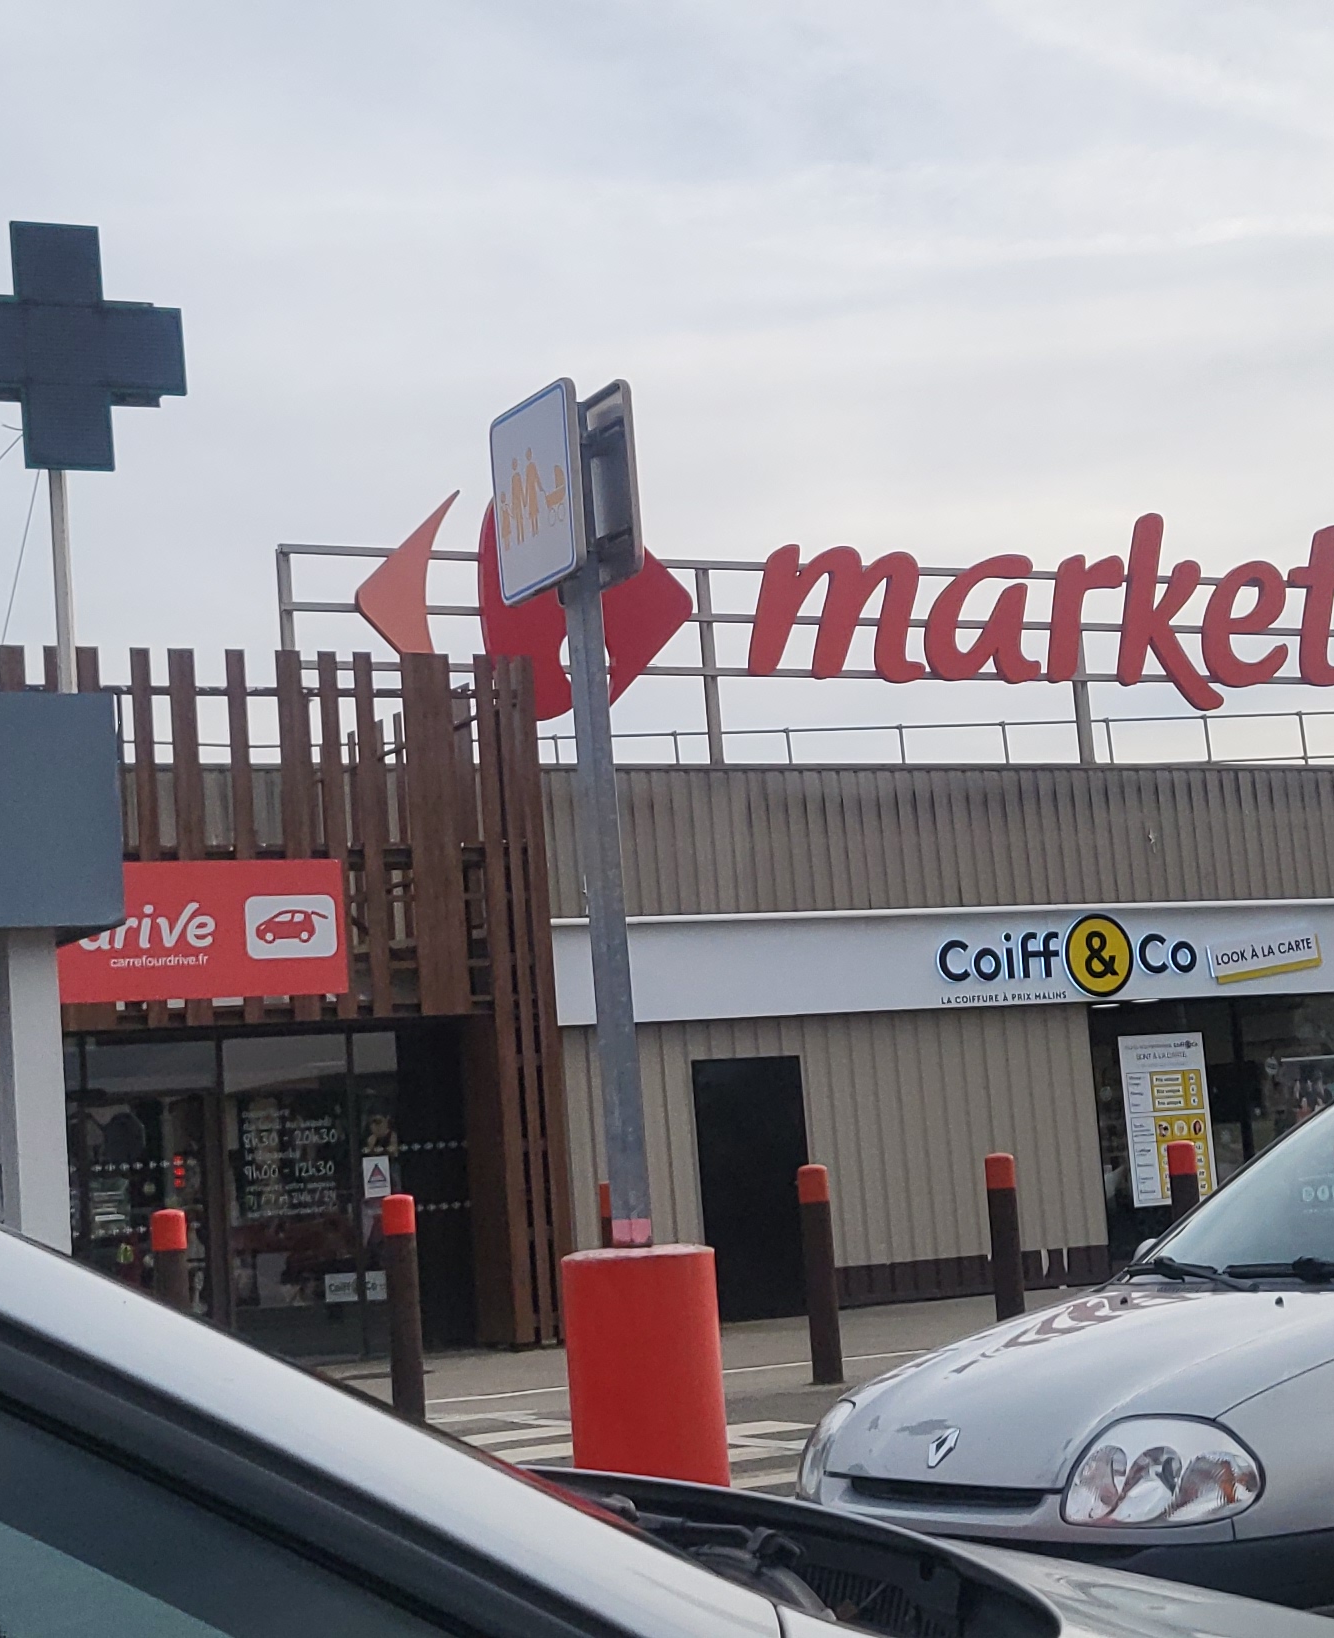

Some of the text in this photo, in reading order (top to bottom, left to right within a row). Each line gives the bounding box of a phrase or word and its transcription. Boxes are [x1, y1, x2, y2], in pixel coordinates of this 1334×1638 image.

[110, 953, 209, 967] carrefourdrive.fr
[1215, 937, 1313, 966] LOOK À LA CARTE
[941, 990, 1067, 1005] LA COIFFURE À PRIX MALINS
[242, 1130, 279, 1149] 8h30
[294, 1128, 338, 1145] 20h30
[242, 1164, 279, 1181] 9h00
[294, 1160, 335, 1177] 12h30
